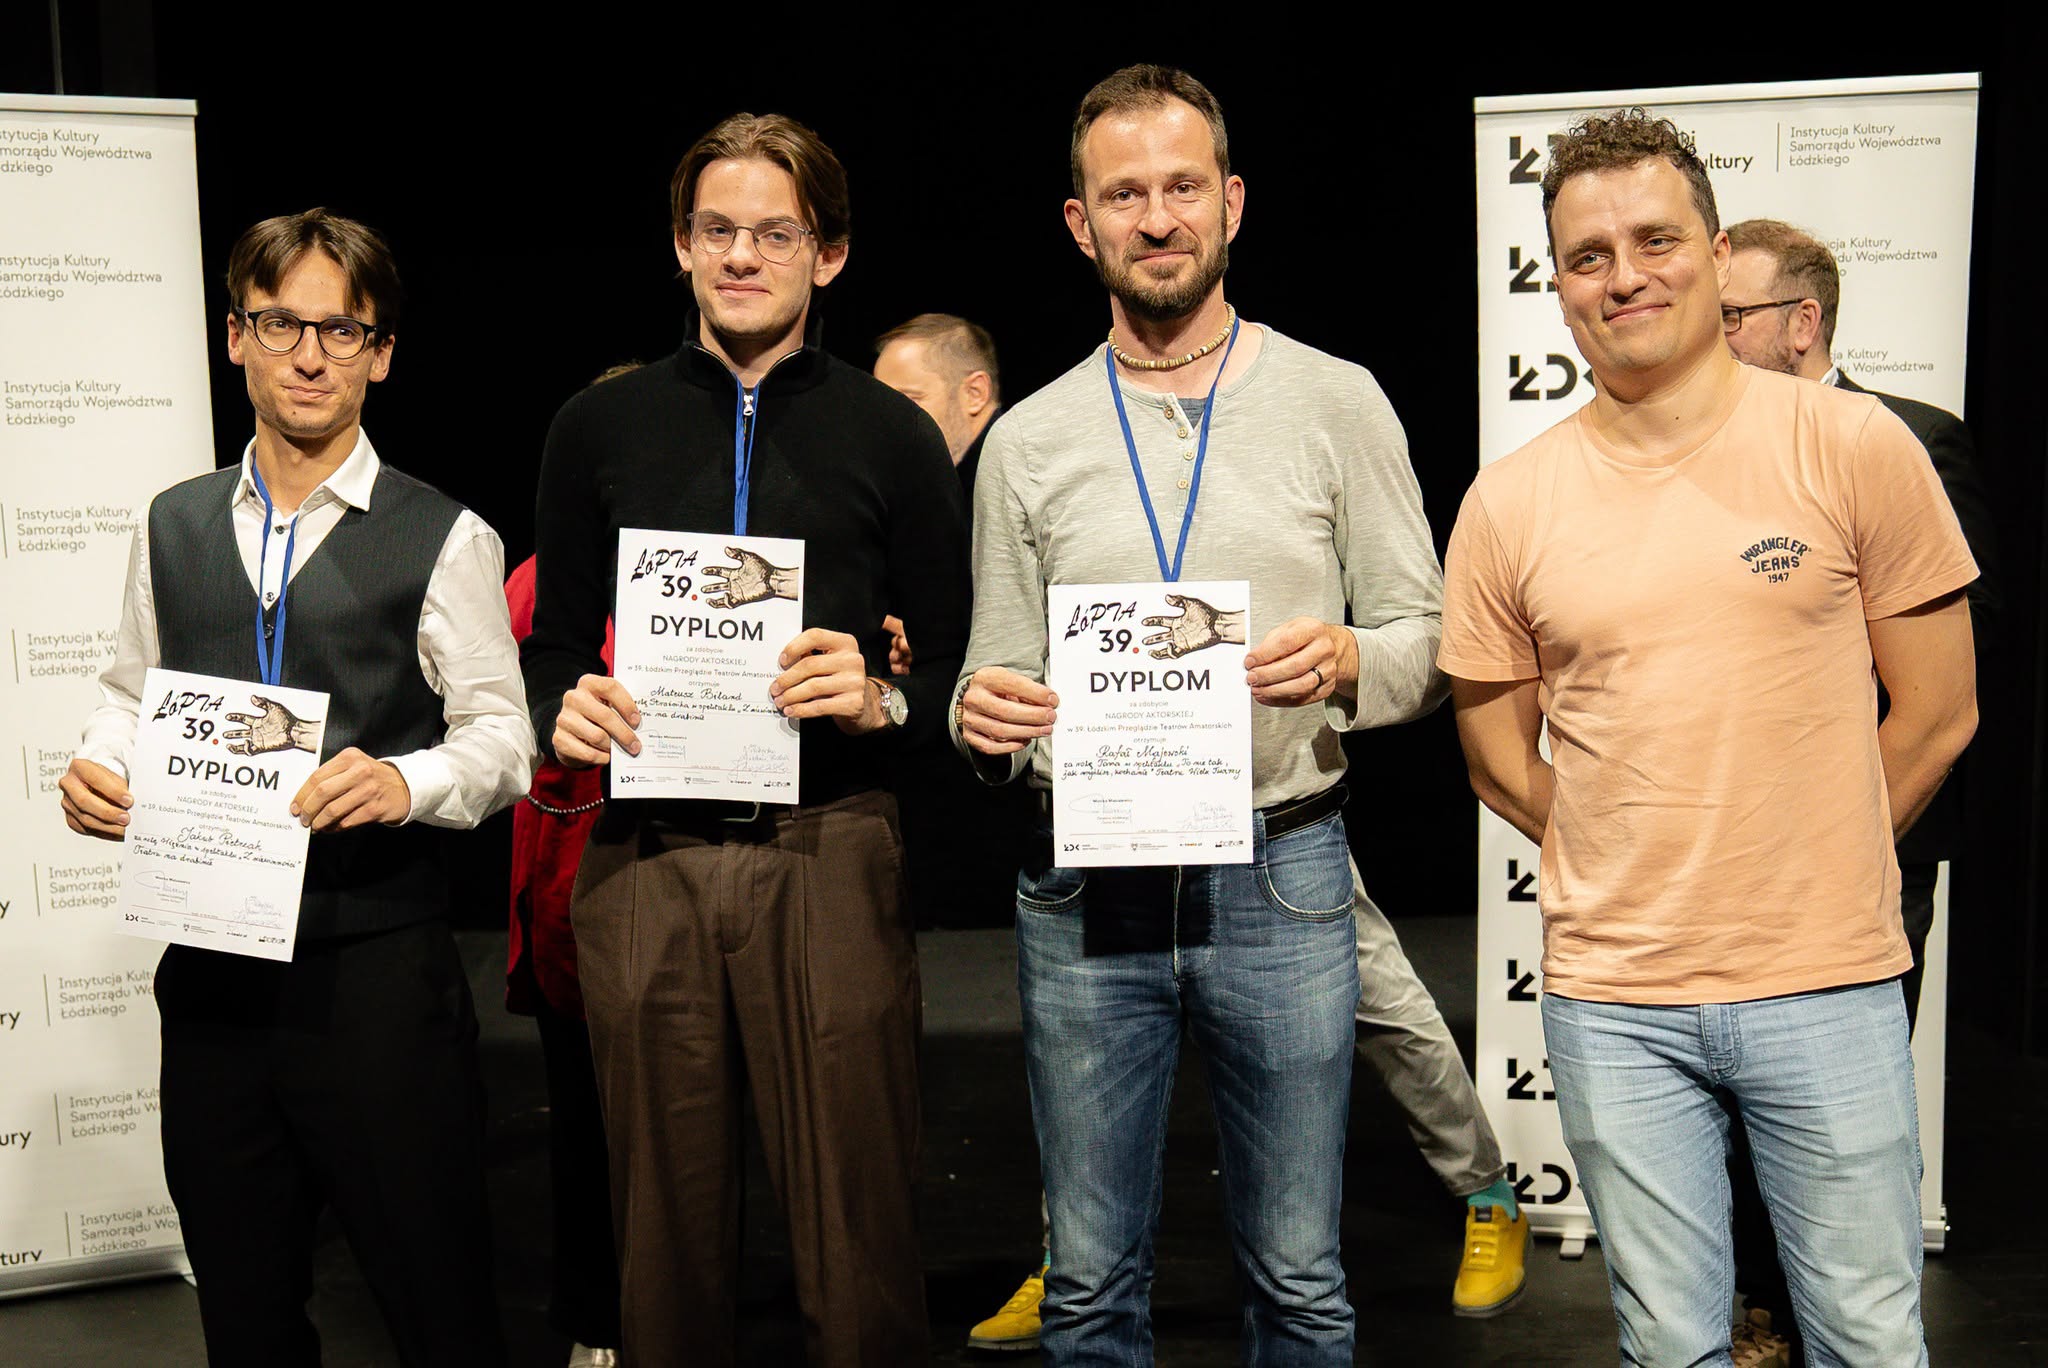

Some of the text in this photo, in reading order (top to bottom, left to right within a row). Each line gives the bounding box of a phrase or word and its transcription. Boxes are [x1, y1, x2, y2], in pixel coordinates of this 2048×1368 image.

[0, 129, 100, 146] tytucja Kultury
[1791, 123, 1895, 139] Instytucja Kultury
[1790, 136, 1942, 153] Samorządu Województwa
[0, 145, 153, 161] morządu Województwa
[1789, 153, 1850, 167] Łódzkiego
[0, 161, 54, 177] dzkiego
[1704, 153, 1754, 174] ltury
[1850, 237, 1892, 250] Kultury
[0, 254, 111, 269] nstytucja Kultury
[1856, 249, 1938, 264] Województwa
[0, 270, 163, 286] amorządu Województwa
[1847, 348, 1889, 361] Kultury
[1853, 361, 1935, 376] Województwa
[4, 380, 122, 395] Instytucja Kultury
[5, 395, 173, 412] Samorządu Województwa
[6, 413, 76, 428] Łódzkiego
[16, 505, 132, 522] Instytucja Kultury
[17, 522, 91, 537] Samorządu
[18, 538, 87, 553] Łódzkiego
[1740, 537, 1809, 562] WRANGLER
[1751, 556, 1800, 573] JEANS
[1768, 572, 1790, 583] 1947
[661, 574, 698, 601] 39.
[650, 614, 764, 642] DYPLOM
[28, 632, 93, 647] Instytucja
[1098, 629, 1140, 654] 39.
[28, 647, 102, 661] Samorządu
[694, 646, 724, 655] zdobycie
[662, 655, 747, 666] NAGRODY AKTORSKIEJ
[30, 663, 97, 678] Łódzkiego
[645, 664, 673, 674] Łódzkim
[674, 666, 713, 677] Przeglądzie
[714, 669, 741, 678] Teatrów
[688, 681, 720, 689] otrzymuje
[1090, 669, 1211, 694] DYPLOM
[651, 686, 695, 699] Mateusz
[1138, 700, 1169, 708] zdobycie
[1105, 710, 1194, 719] NAGRODY AKTORSKIEJ
[182, 717, 219, 745] 39.
[1087, 724, 1117, 733] Łódzkim
[1118, 723, 1158, 733] Przeglądzie
[1160, 722, 1188, 731] Teatrów
[1189, 721, 1233, 730] Amatorskich
[1133, 736, 1167, 744] otrzymuje
[1096, 744, 1190, 762] Rafał Majewski
[167, 755, 280, 791] DYPLOM
[1061, 769, 1077, 781] jak
[209, 789, 237, 800] zdobycie
[176, 795, 259, 814] NAGRODY AKTORSKIEJ
[159, 804, 186, 815] Łódzkim
[186, 808, 224, 821] Przeglądzie
[225, 814, 251, 825] Teatrów
[252, 818, 293, 831] Amatorskich
[177, 827, 214, 843] Jakub
[48, 862, 113, 879] Instytucja
[49, 878, 121, 894] Samorządu
[51, 895, 117, 909] Łódzkiego
[58, 973, 122, 990] Instytucja
[60, 987, 131, 1004] Samorządu
[61, 1004, 127, 1019] Łódzkiego
[69, 1091, 133, 1108] Instytucja
[70, 1105, 141, 1123] Samorządu
[72, 1122, 137, 1138] Łódzkiego
[80, 1207, 143, 1226] Instytucja
[81, 1221, 151, 1241] Samorządu
[0, 1249, 42, 1266] tury
